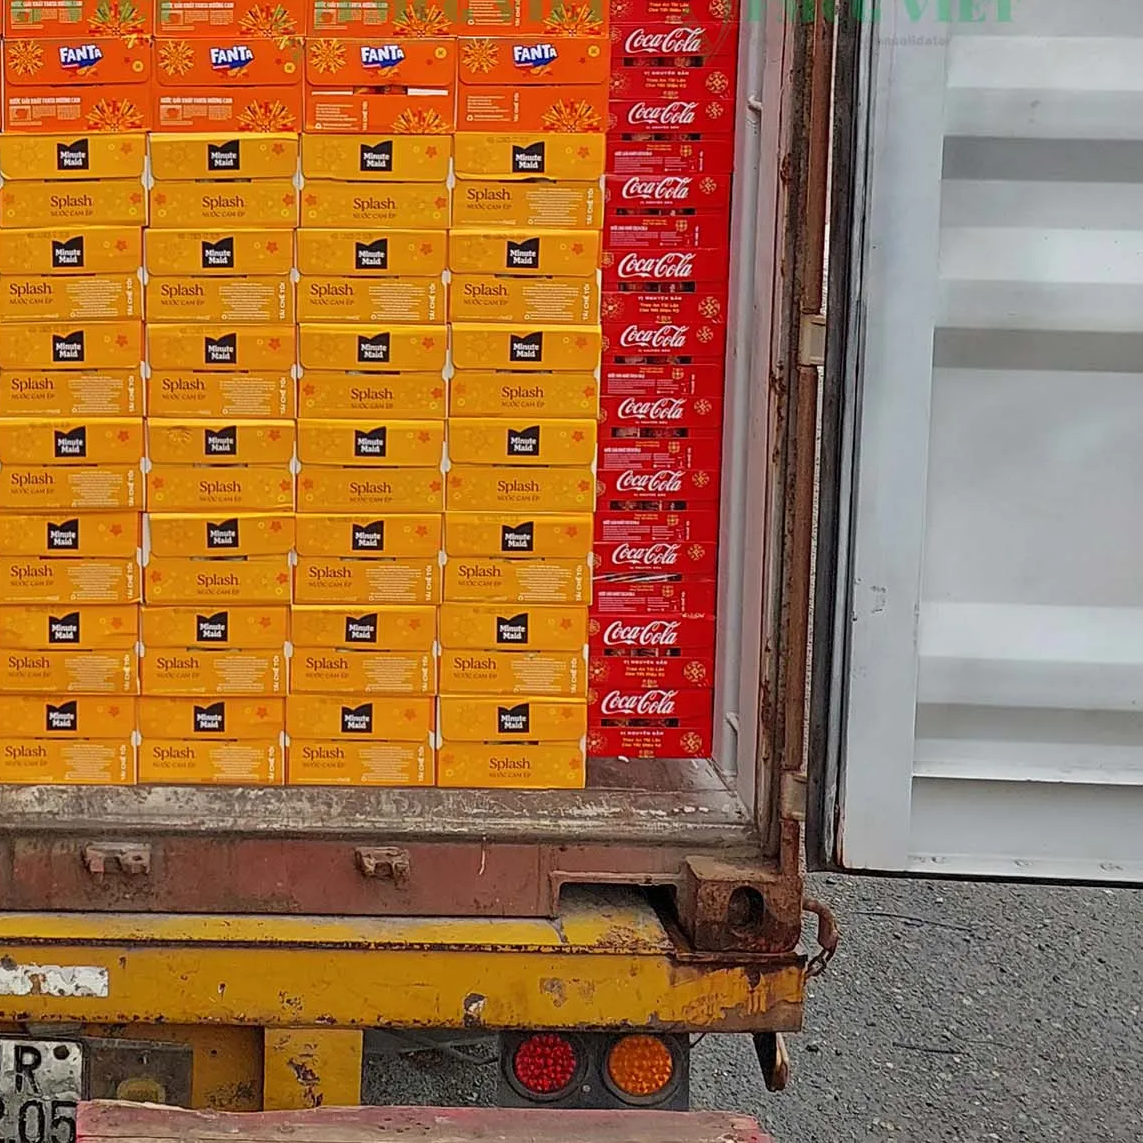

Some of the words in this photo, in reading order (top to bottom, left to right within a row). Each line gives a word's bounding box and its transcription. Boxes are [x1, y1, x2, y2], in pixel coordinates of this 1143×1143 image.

[625, 27, 707, 54] Coca-Cola
[60, 44, 105, 63] FANTA
[513, 44, 558, 62] FANTA
[628, 101, 699, 124] Coca-Cola
[211, 151, 237, 160] Minute
[214, 159, 234, 168] Maid
[621, 176, 693, 199] Coca-Cola
[201, 194, 244, 212] Splash
[204, 249, 231, 257] Minute
[208, 256, 228, 266] Maid
[617, 252, 697, 278] Coca-Cola
[8, 281, 52, 300] Splash
[620, 324, 691, 347] Coca-Cola
[208, 344, 234, 353] Minute
[211, 352, 231, 361] Maid
[10, 376, 53, 394] Splash
[617, 397, 687, 419] Coca-Cola
[208, 436, 234, 445] Minute
[211, 444, 231, 453] Maid
[198, 479, 241, 497] Splash
[616, 469, 685, 492] Coca-Cola
[210, 529, 236, 538] Minute
[213, 537, 233, 546] Maid
[611, 543, 681, 565] Coca-Cola
[308, 564, 351, 582] Splash
[199, 622, 226, 631] Minute
[202, 630, 222, 639] Maid
[603, 620, 682, 646] Coca-Cola
[452, 655, 496, 674] Splash
[601, 689, 679, 715] Coca-Cola
[3, 743, 47, 762] Splash
